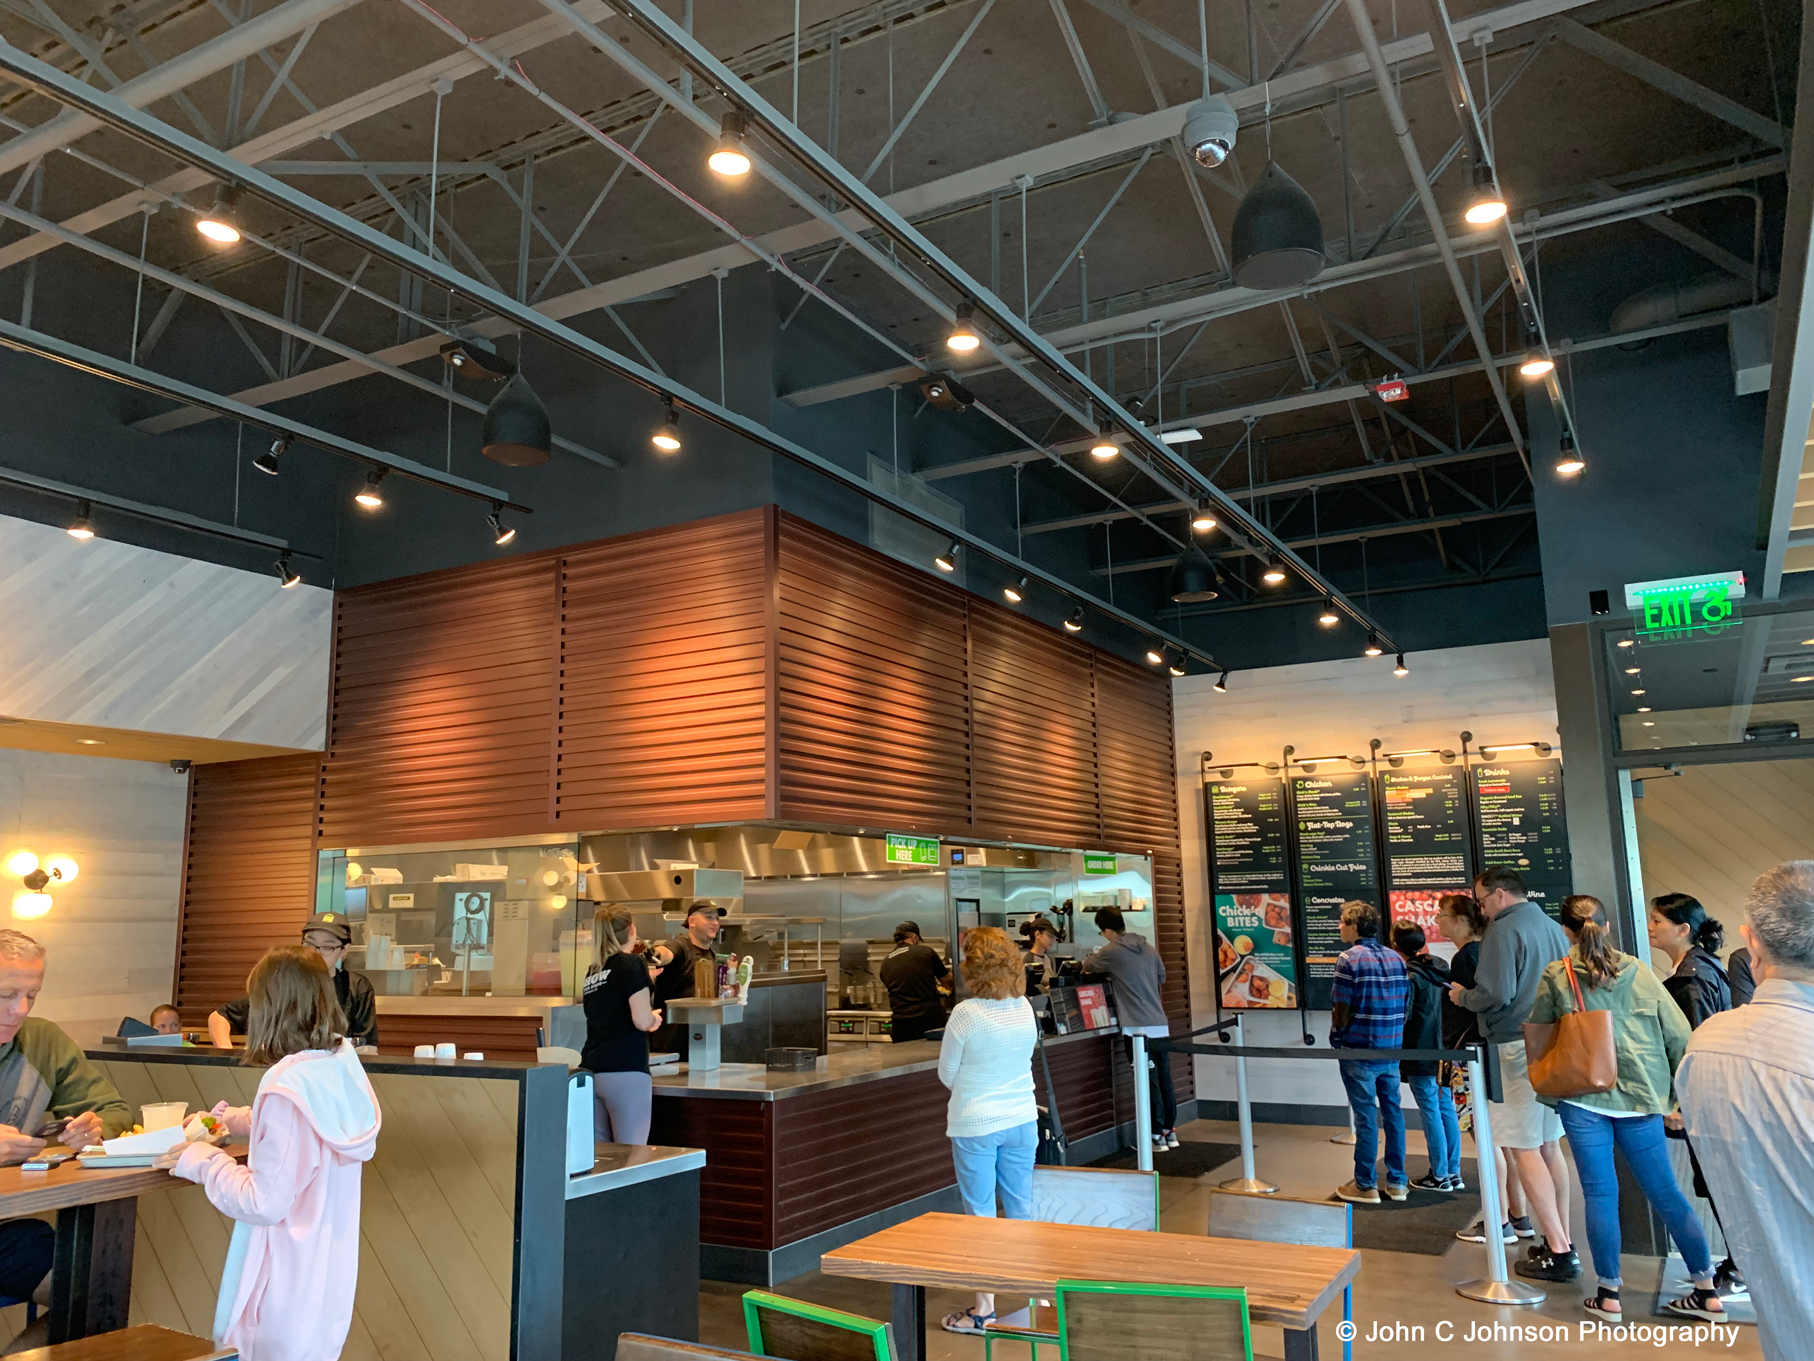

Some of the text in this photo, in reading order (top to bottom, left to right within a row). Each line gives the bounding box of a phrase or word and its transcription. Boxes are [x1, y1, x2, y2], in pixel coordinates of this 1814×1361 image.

[1643, 592, 1692, 628] EXIT
[1484, 768, 1510, 776] Drinks
[1306, 820, 1353, 830] Flat-Top Dogs
[890, 838, 917, 850] PICK UP
[896, 850, 912, 861] HERE
[1349, 864, 1367, 872] Fries
[1395, 900, 1440, 912] CASCA
[1227, 916, 1259, 927] BITES
